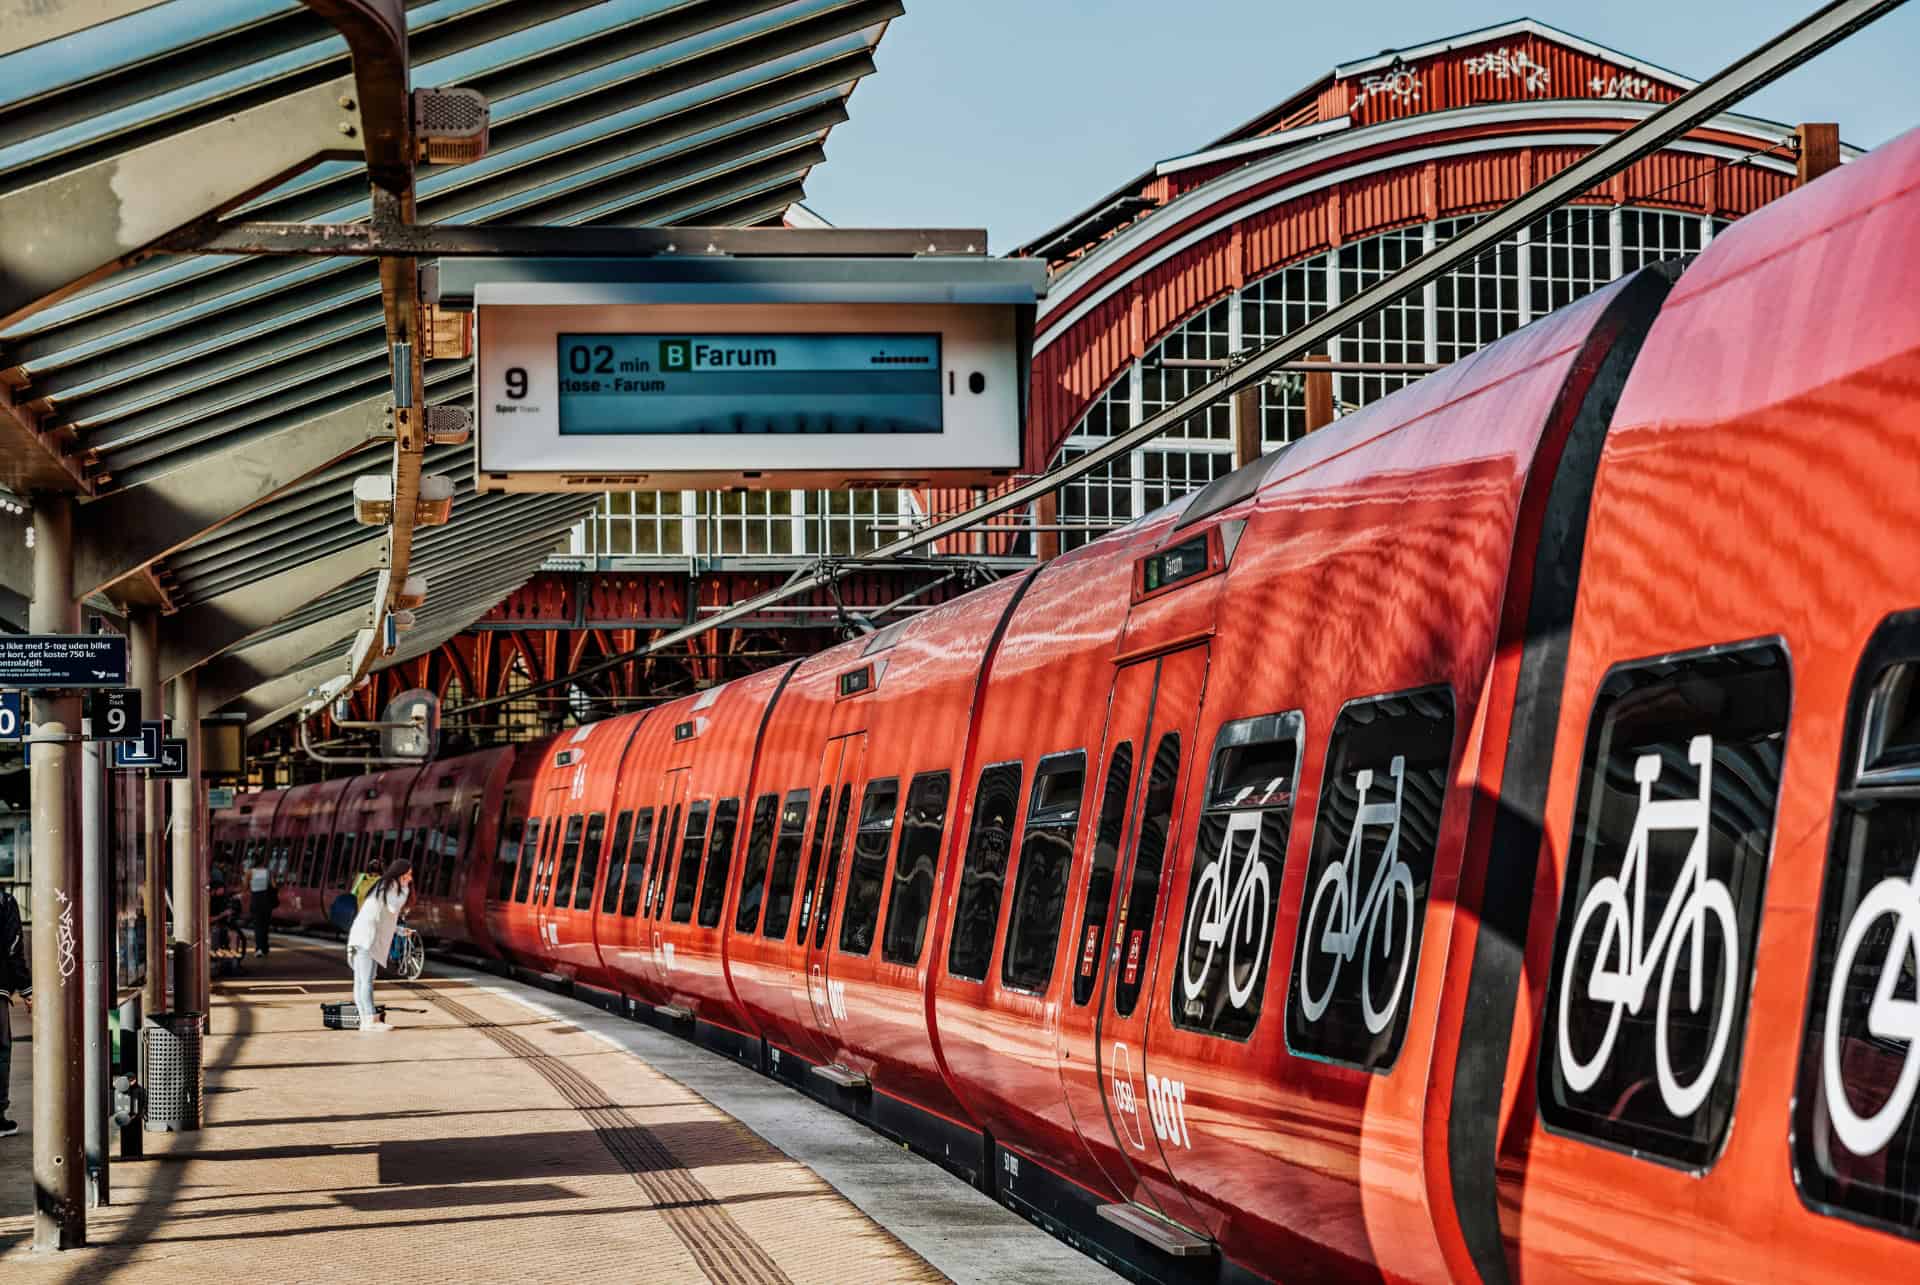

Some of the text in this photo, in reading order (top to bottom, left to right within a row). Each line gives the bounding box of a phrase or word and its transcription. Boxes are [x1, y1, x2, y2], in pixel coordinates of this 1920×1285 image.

[570, 345, 649, 374] 02 min
[668, 345, 684, 366] B
[695, 345, 777, 366] Farum
[505, 367, 528, 399] 9
[614, 378, 666, 392] Farum
[25, 642, 43, 650] med
[68, 642, 89, 650] uden
[90, 641, 111, 650] billet
[28, 650, 42, 658] det
[43, 650, 68, 658] koster
[69, 650, 84, 658] 750
[107, 708, 126, 733] 9
